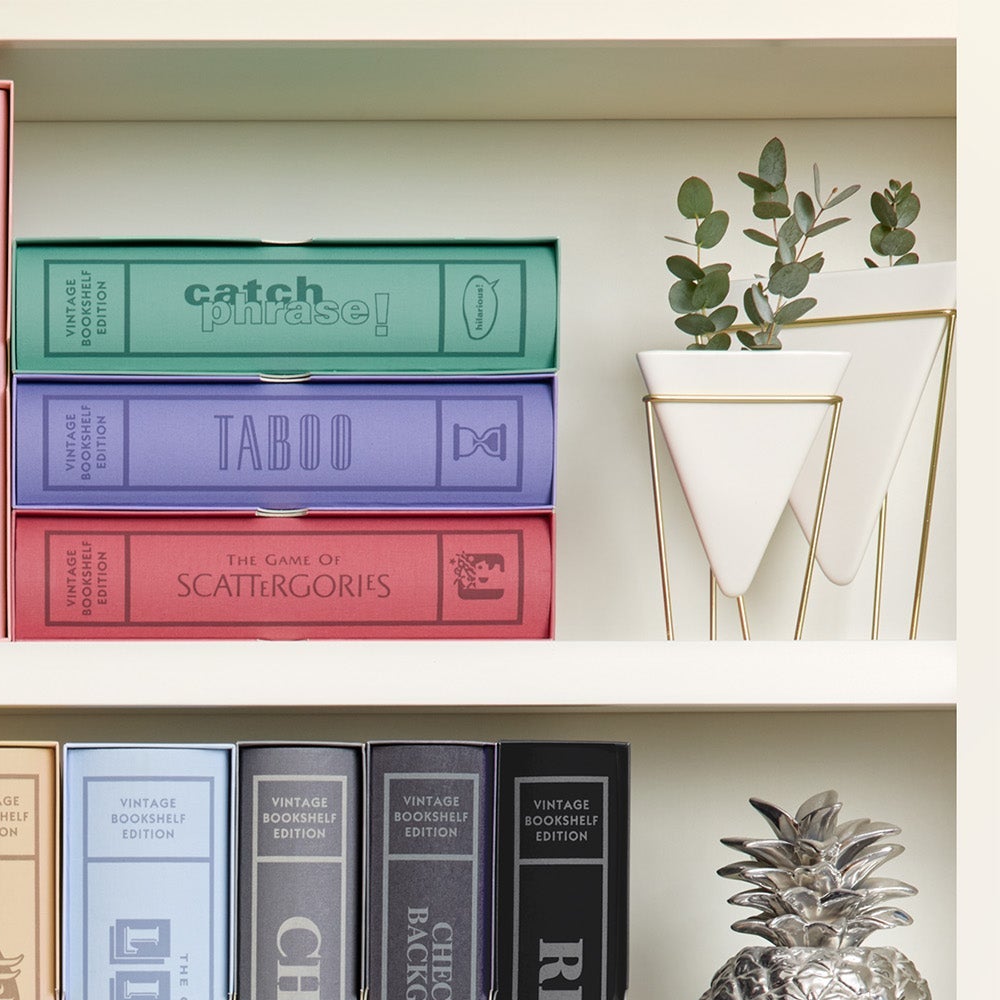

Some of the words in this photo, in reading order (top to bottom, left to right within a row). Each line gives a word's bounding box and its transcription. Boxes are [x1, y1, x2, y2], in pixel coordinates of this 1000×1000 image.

[184, 275, 324, 306] catch
[65, 279, 77, 338] VINTAGE
[80, 269, 92, 347] BOOKSHELF
[96, 280, 107, 335] EDITION
[201, 289, 390, 337] phrase!
[475, 284, 484, 331] hilarious!
[65, 413, 76, 472] VINTAGE
[80, 404, 92, 481] BOOKSHELF
[95, 415, 107, 469] EDITION
[214, 414, 352, 471] TABOO
[227, 554, 260, 566] THE
[265, 553, 315, 567] GAME
[318, 553, 342, 567] OF
[66, 550, 77, 607] VINTAGE
[81, 540, 93, 617] BOOKSHELF
[96, 551, 108, 605] EDITION
[119, 797, 177, 809] VINTAGE
[271, 796, 328, 808] VINTAGE
[402, 795, 460, 807] VINTAGE
[533, 799, 590, 811] VINTAGE
[111, 813, 186, 824] BOOKSHELF
[262, 812, 337, 824] BOOKSHELF
[394, 811, 469, 823] BOOKSHELF
[404, 826, 458, 838] EDITION
[524, 815, 599, 826] BOOKSHELF
[122, 828, 175, 840] EDITION
[273, 827, 326, 839] EDITION
[535, 830, 588, 842] EDITION
[179, 953, 189, 987] THE
